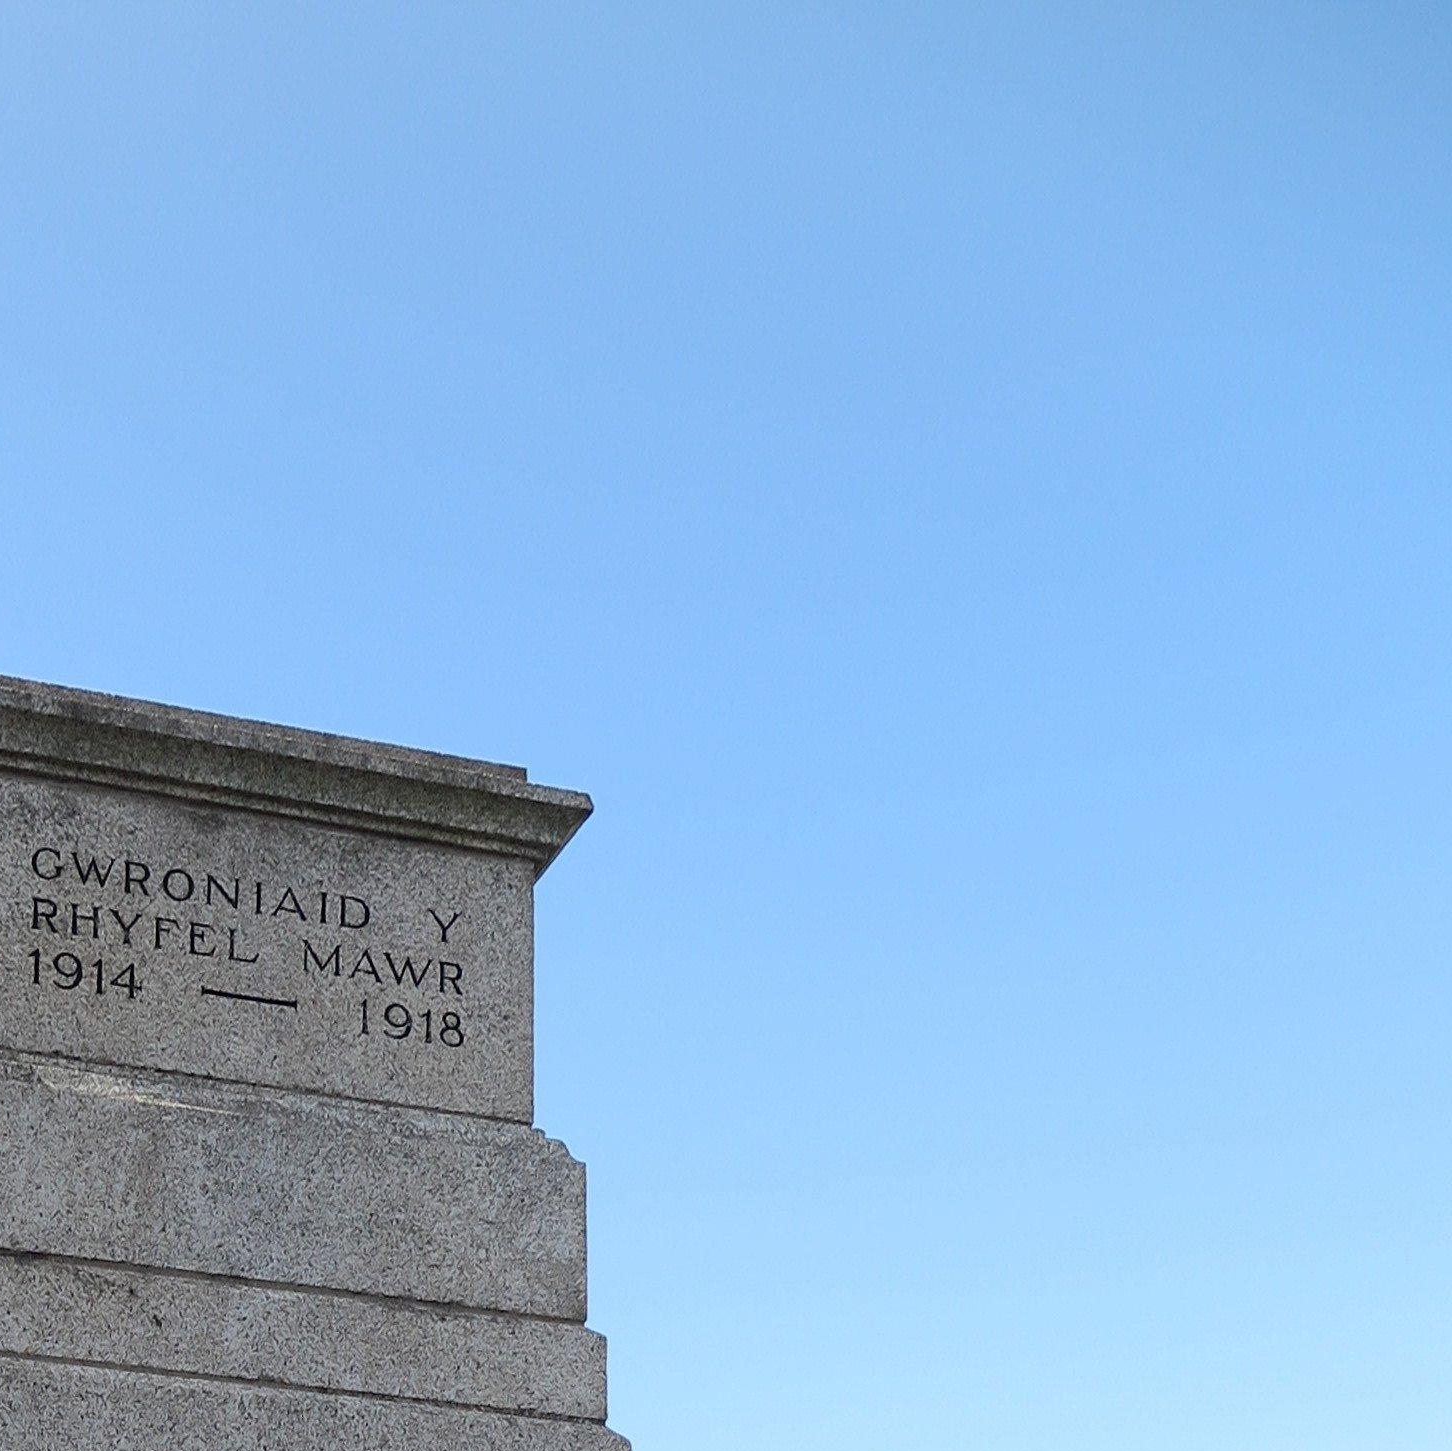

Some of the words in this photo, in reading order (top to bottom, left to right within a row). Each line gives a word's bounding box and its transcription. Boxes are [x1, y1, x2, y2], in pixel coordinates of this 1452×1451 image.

[31, 846, 371, 930] GWRONIAID
[430, 908, 464, 943] Y
[31, 896, 261, 965] RHYFEL
[302, 938, 465, 996] MAWR
[27, 947, 144, 1000] 1914
[359, 999, 466, 1050] 1918
